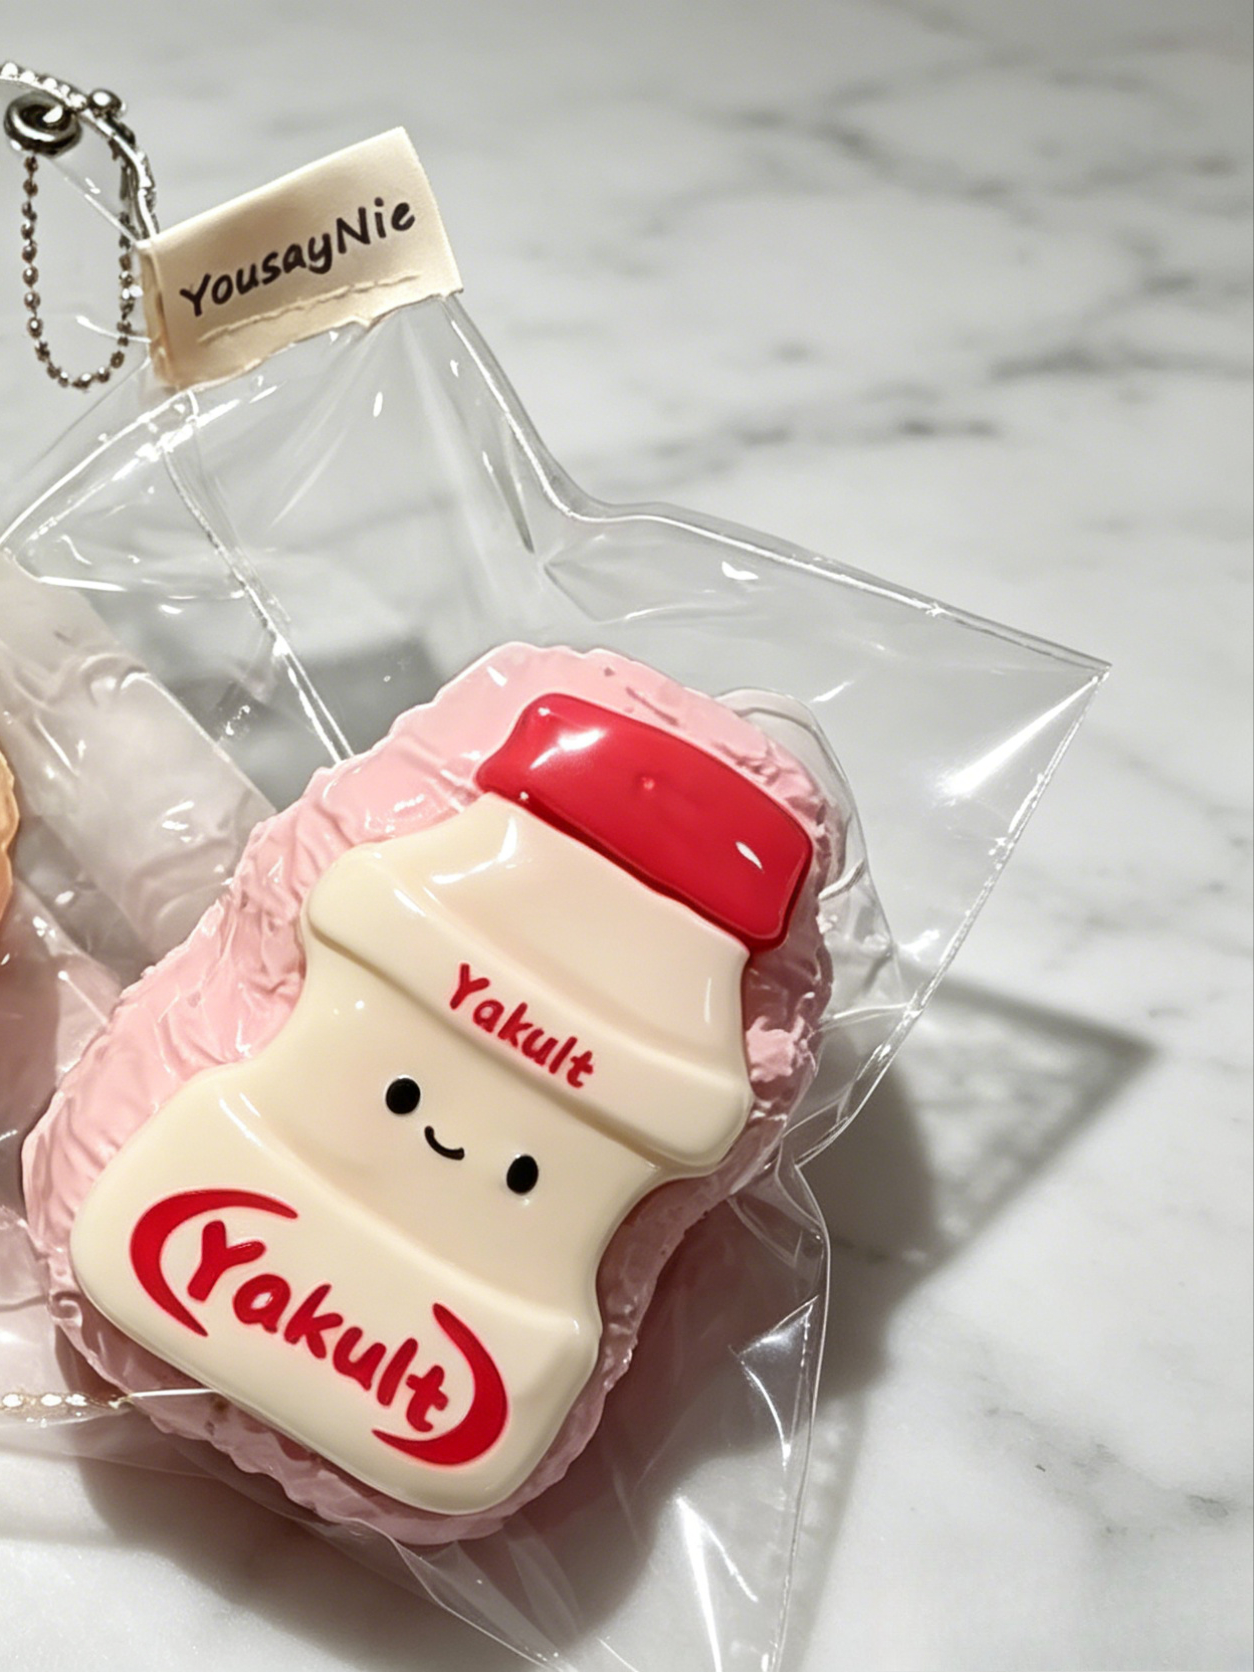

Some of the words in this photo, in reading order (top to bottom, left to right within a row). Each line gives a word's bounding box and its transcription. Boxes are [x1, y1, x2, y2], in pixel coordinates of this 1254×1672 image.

[179, 197, 415, 318] YousayNie
[448, 962, 595, 1089] Yakult
[185, 1218, 450, 1435] Yakult
